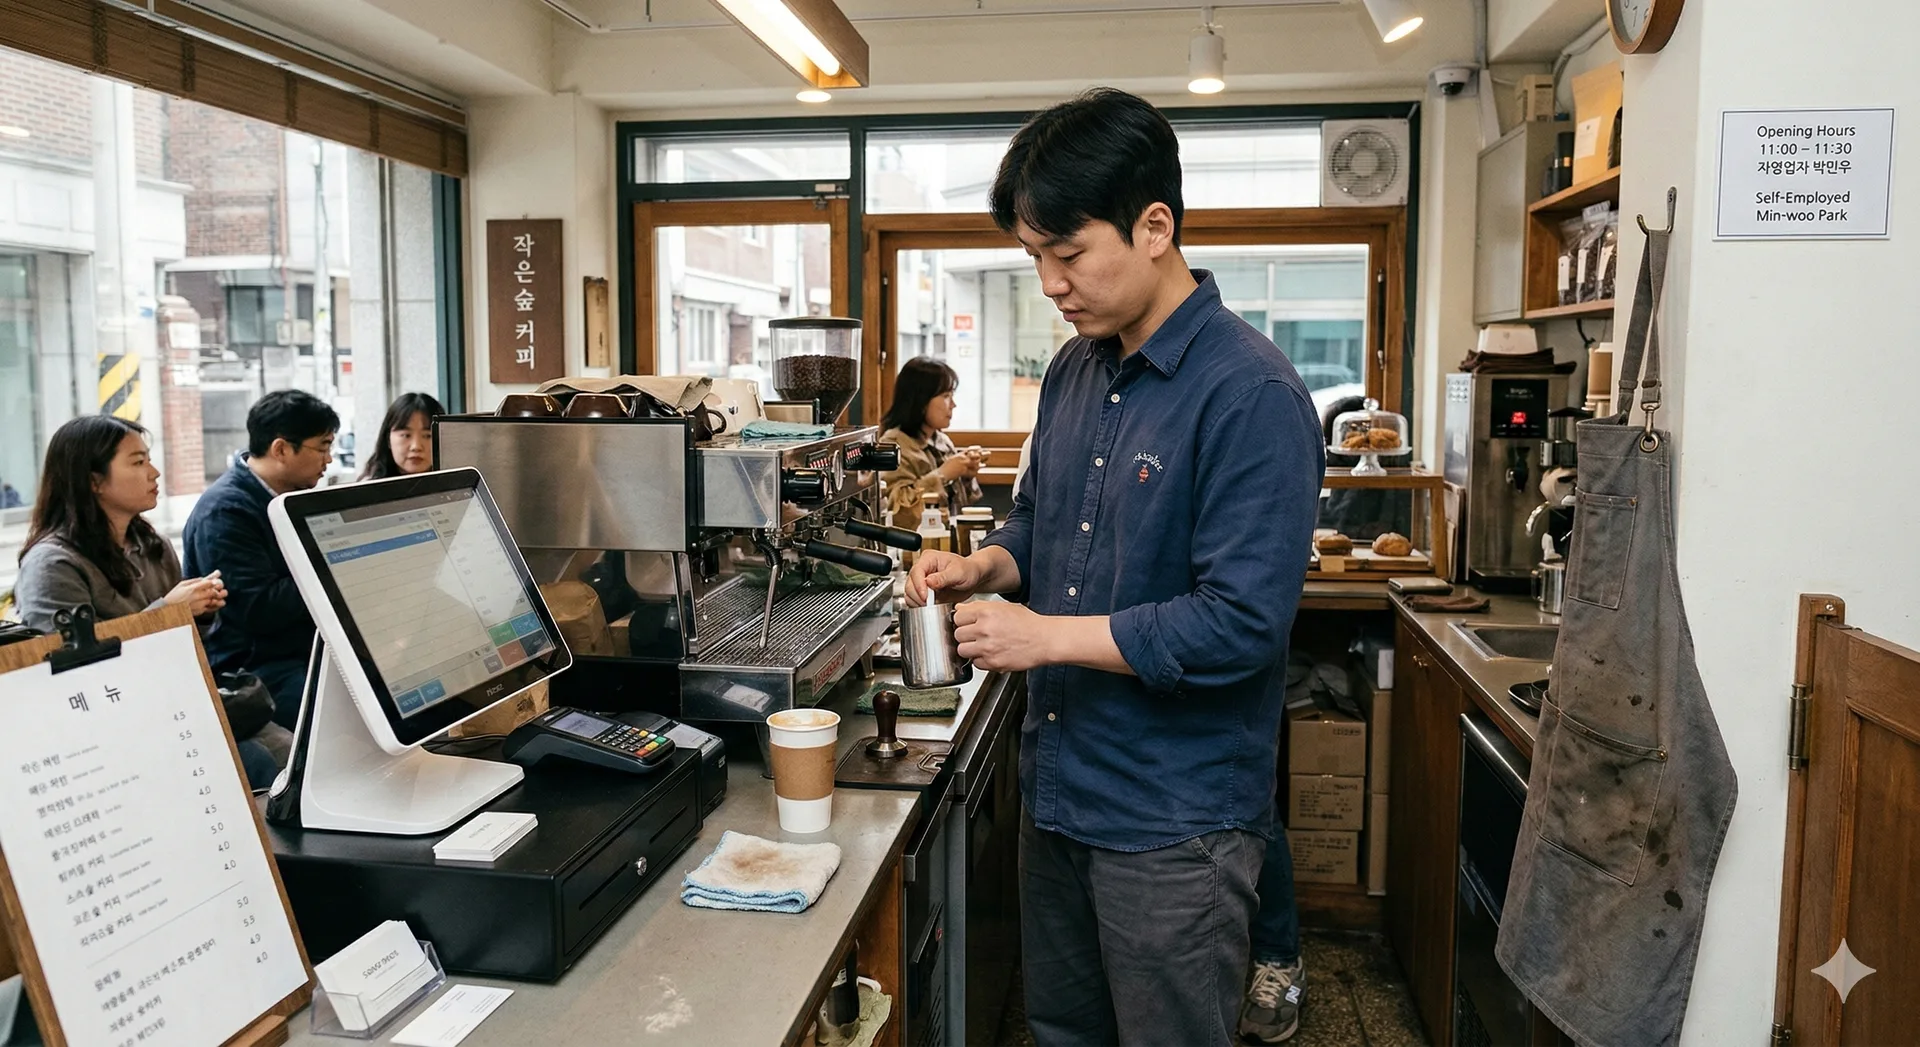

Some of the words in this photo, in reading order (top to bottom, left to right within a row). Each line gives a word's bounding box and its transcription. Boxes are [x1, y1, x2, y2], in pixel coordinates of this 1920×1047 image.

[1756, 124, 1813, 140] Opening
[1816, 124, 1856, 137] Hours
[1760, 142, 1798, 156] 11:00
[1814, 142, 1852, 155] 11:30
[1756, 160, 1810, 176] 자영업자
[1812, 159, 1852, 175] 박민우
[1755, 190, 1851, 206] Self-Employed
[1756, 208, 1815, 222] Min-woo
[1818, 208, 1848, 222] Park
